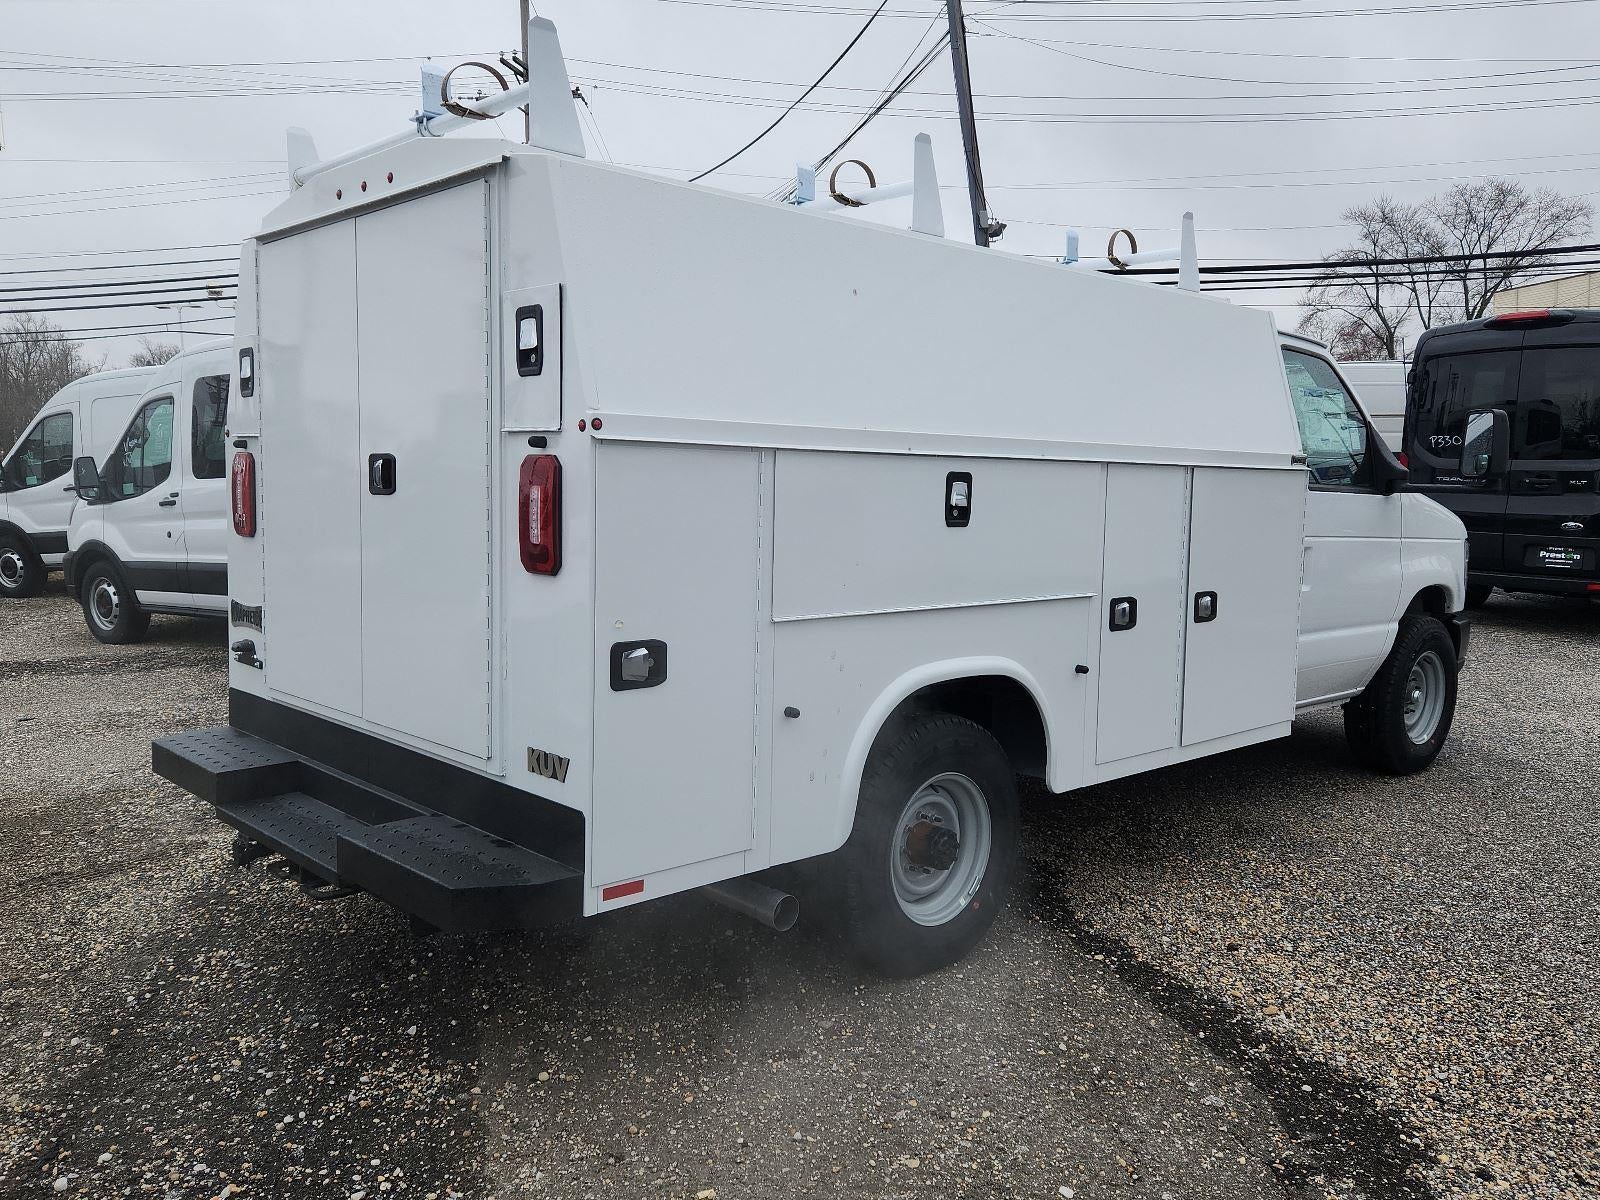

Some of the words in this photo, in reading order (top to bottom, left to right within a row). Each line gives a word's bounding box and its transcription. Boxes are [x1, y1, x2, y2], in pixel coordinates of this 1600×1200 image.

[1429, 435, 1462, 448] P330
[1539, 550, 1581, 560] Preston
[527, 746, 570, 784] KUV
